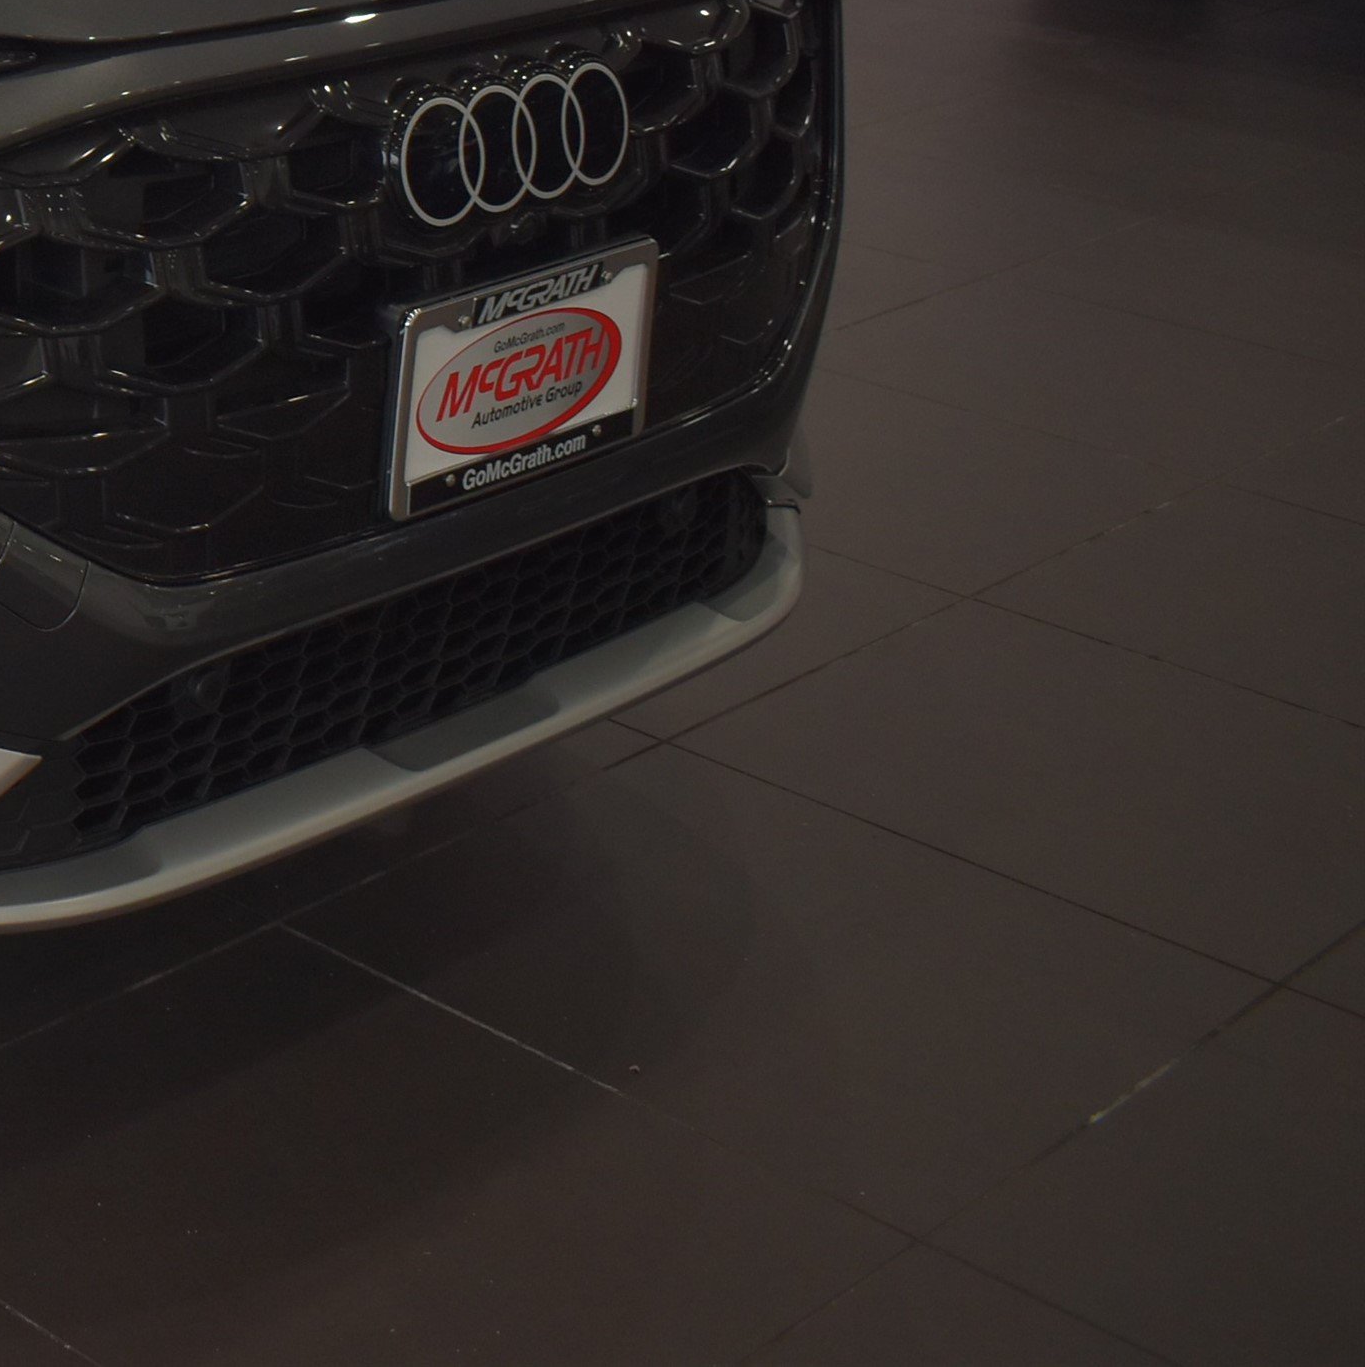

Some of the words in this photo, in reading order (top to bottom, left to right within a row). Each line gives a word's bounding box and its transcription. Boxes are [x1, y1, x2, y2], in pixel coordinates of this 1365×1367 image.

[493, 321, 566, 354] GoMcGrath.com
[471, 391, 544, 430] Automotive
[545, 379, 583, 404] Group
[461, 434, 587, 491] GoMcGrath.com
